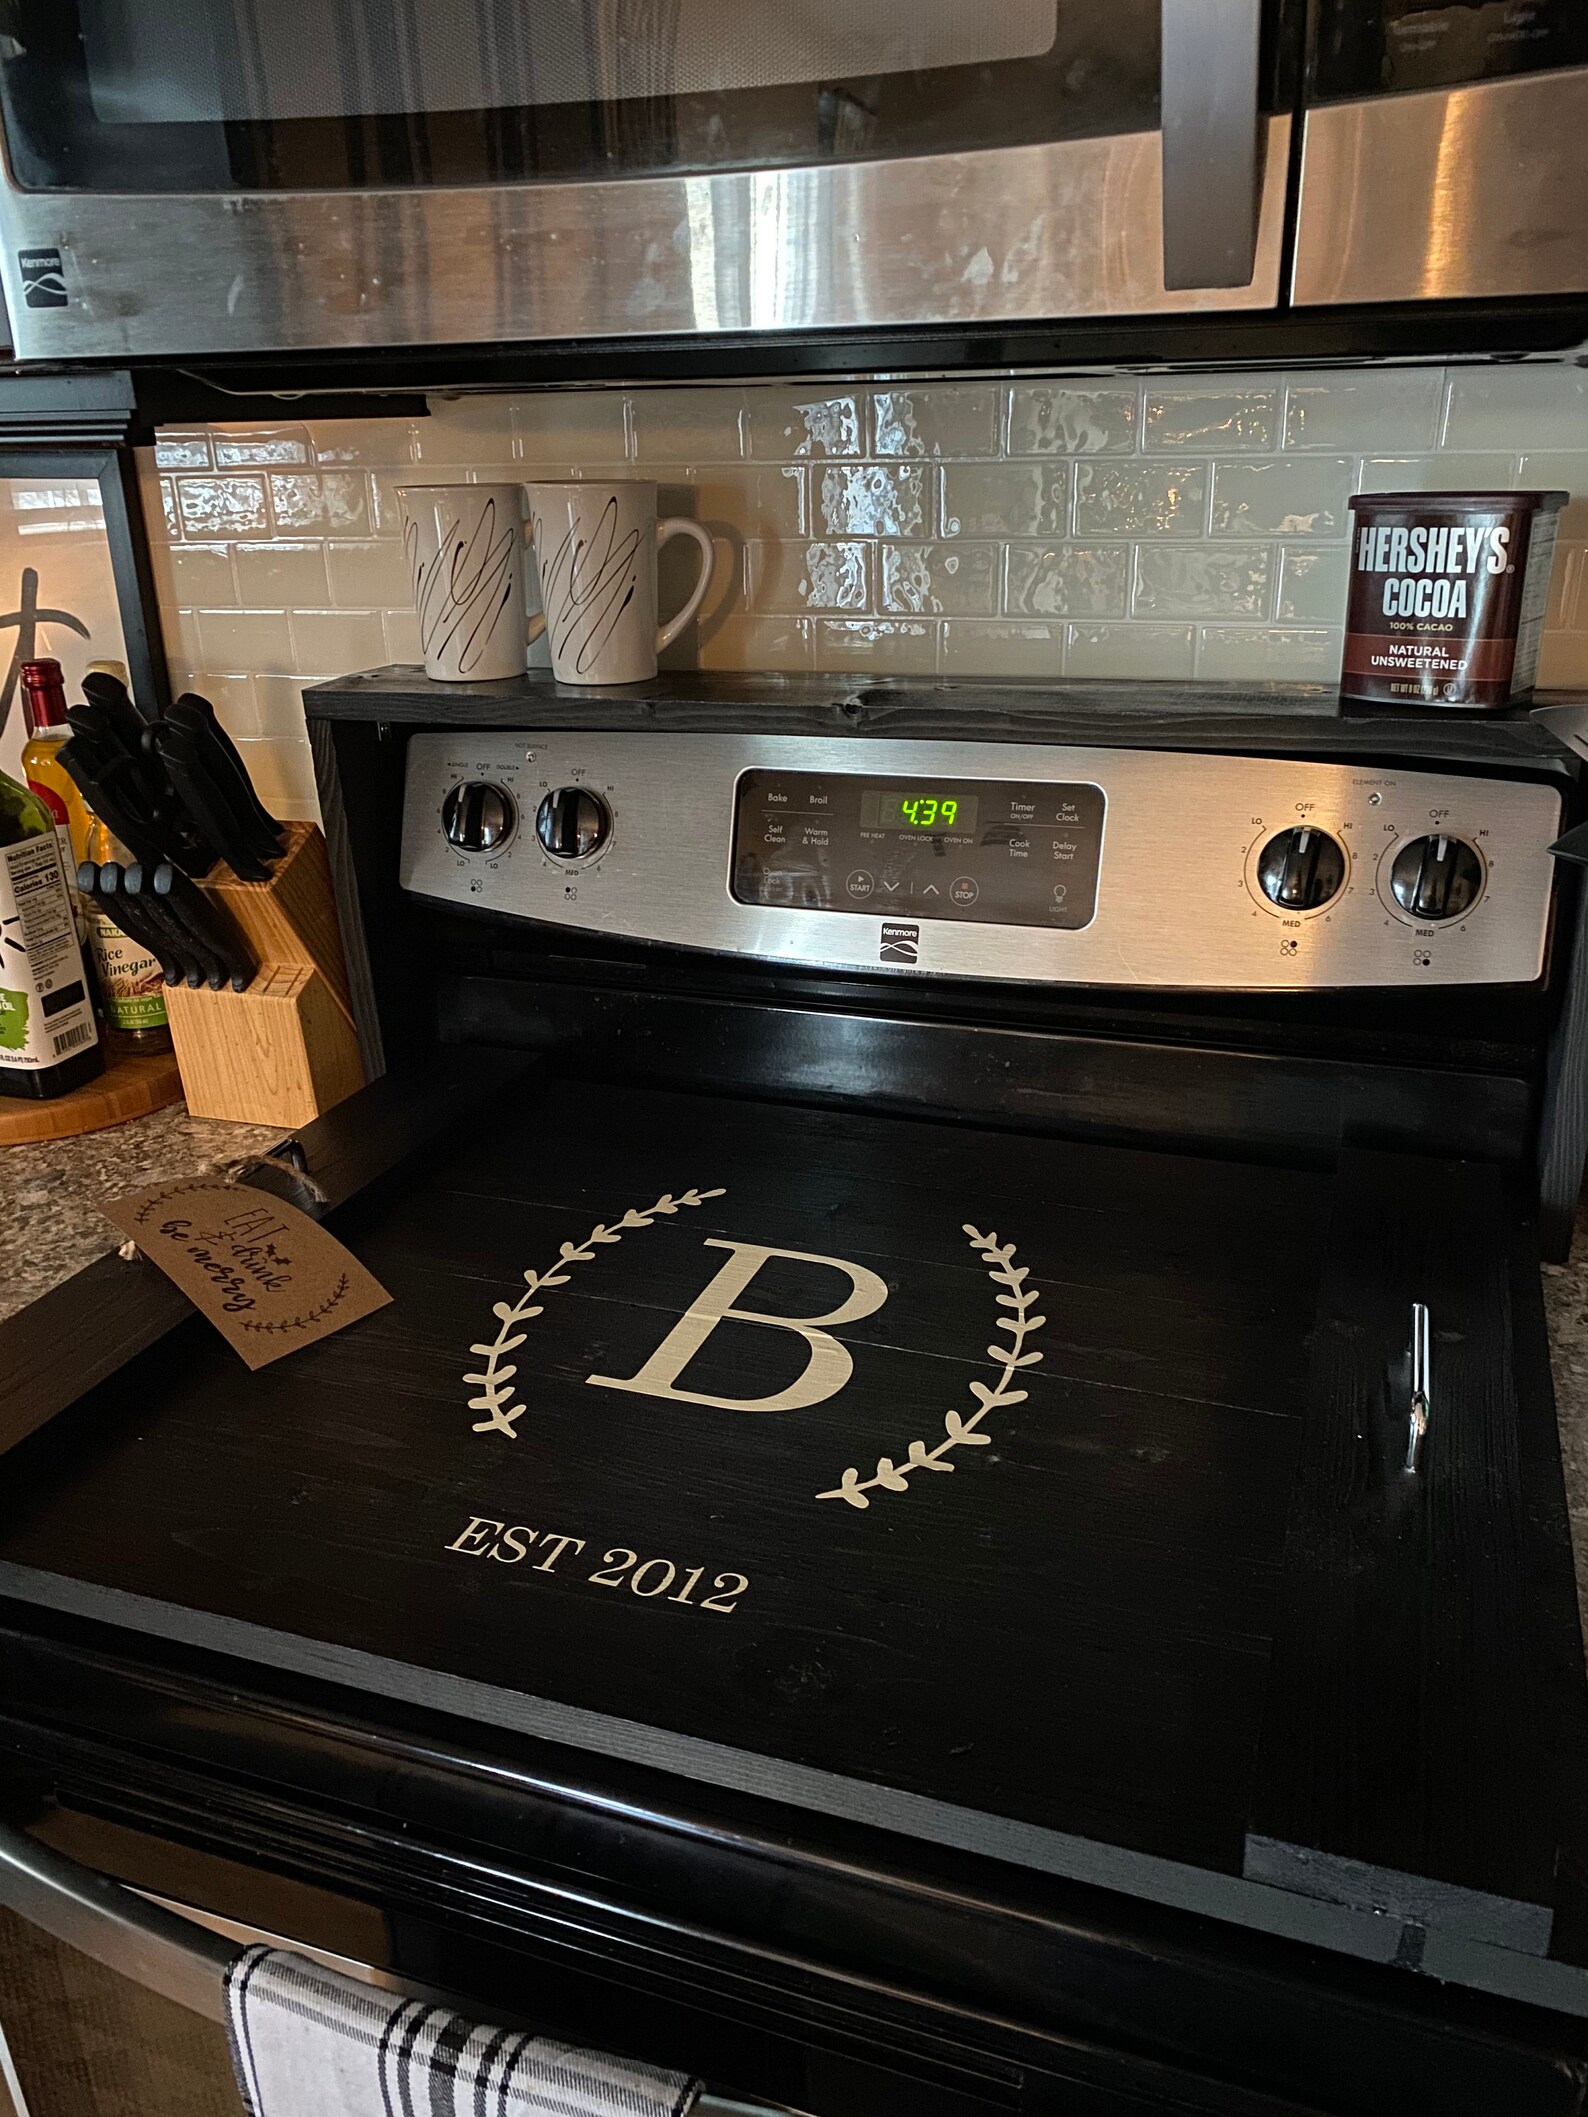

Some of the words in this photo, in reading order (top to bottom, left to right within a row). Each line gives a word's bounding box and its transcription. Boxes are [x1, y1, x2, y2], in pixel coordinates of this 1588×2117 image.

[20, 257, 60, 268] Kenmore
[1357, 526, 1511, 575] HERSHEY'S
[1382, 578, 1467, 618] COCOA
[1389, 621, 1414, 630] 100%
[1416, 623, 1454, 632] CACAO
[1389, 644, 1450, 657] NATURAL
[1371, 655, 1468, 670] UNSWEETENED
[1390, 683, 1400, 692] NET
[476, 763, 491, 771] OFF
[571, 768, 587, 776] OFF
[1352, 779, 1383, 787] ELEMENT
[767, 792, 788, 803] Bake
[809, 795, 828, 805] Broil
[1010, 801, 1036, 812] Timer
[1061, 803, 1075, 812] Set
[1295, 802, 1315, 812] OFF
[902, 799, 958, 825] 4:39
[1055, 812, 1080, 822] Clock
[1429, 809, 1450, 819] OFF
[1251, 817, 1262, 825] LO
[1343, 822, 1353, 830] HI
[768, 825, 783, 833] Self
[804, 827, 828, 836] Warm
[1383, 824, 1395, 832] LO
[1479, 829, 1489, 837] HI
[764, 834, 786, 843] Clean
[802, 836, 808, 845] &
[811, 837, 829, 846] Hold
[1009, 838, 1031, 848] Cook
[1052, 841, 1077, 852] Delay
[7, 848, 35, 863] Nutrition
[35, 842, 53, 854] Facts
[1009, 849, 1029, 858] Time
[1053, 851, 1074, 860] Start
[14, 879, 43, 894] Calories
[44, 870, 59, 882] 130
[850, 884, 871, 892] START
[954, 891, 974, 899] STOP
[1282, 920, 1301, 928] MED
[99, 928, 127, 937] NAKA
[882, 926, 918, 938] Kenmore
[1415, 929, 1435, 937] MED
[95, 947, 123, 962] Rice
[101, 957, 157, 978] Vinegar
[224, 1208, 290, 1244] EAT
[160, 1220, 193, 1243] be
[187, 1246, 258, 1312] merry
[231, 1244, 293, 1293] drink
[585, 1237, 889, 1413] B
[443, 1515, 588, 1574] EST
[588, 1547, 749, 1614] 2012
